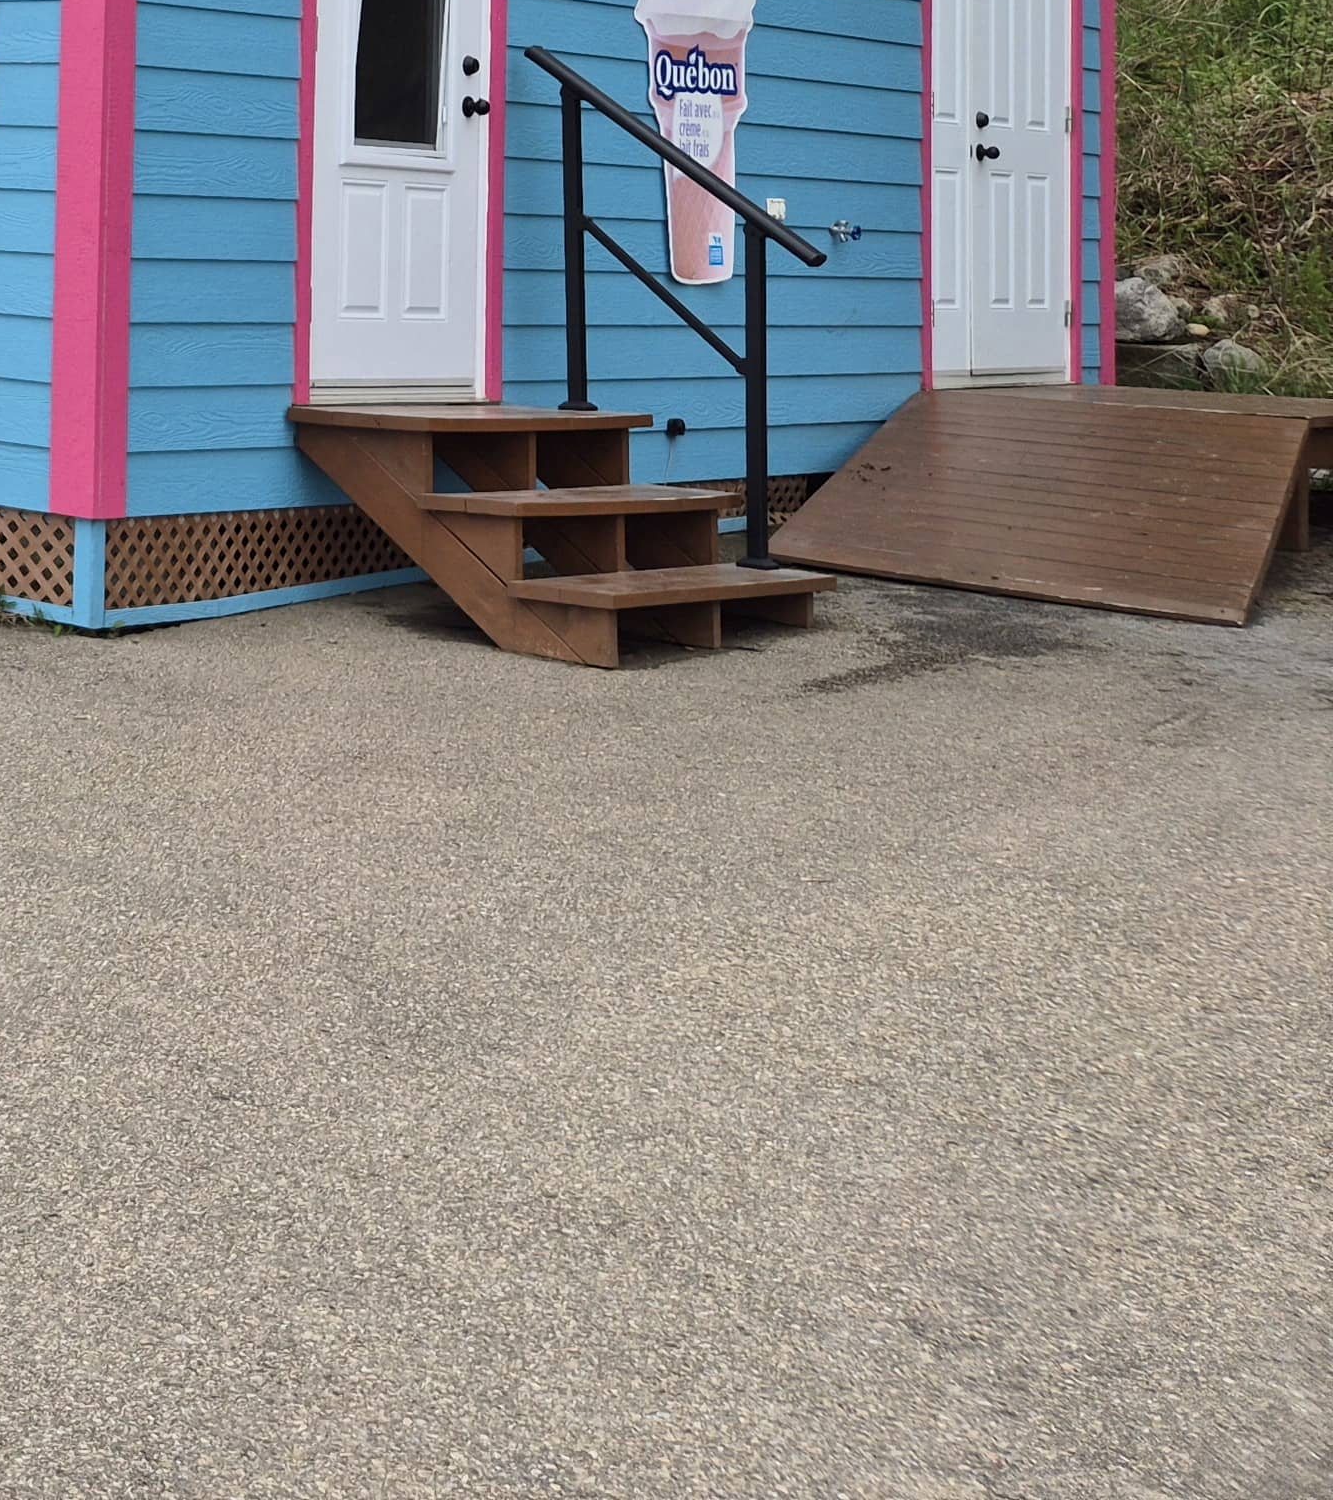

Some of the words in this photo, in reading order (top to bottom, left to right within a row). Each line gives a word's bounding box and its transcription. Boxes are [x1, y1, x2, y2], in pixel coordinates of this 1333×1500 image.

[655, 52, 736, 96] Québon
[679, 99, 693, 117] Fait
[694, 103, 712, 118] avec
[679, 118, 702, 138] crème
[693, 139, 710, 158] frais
